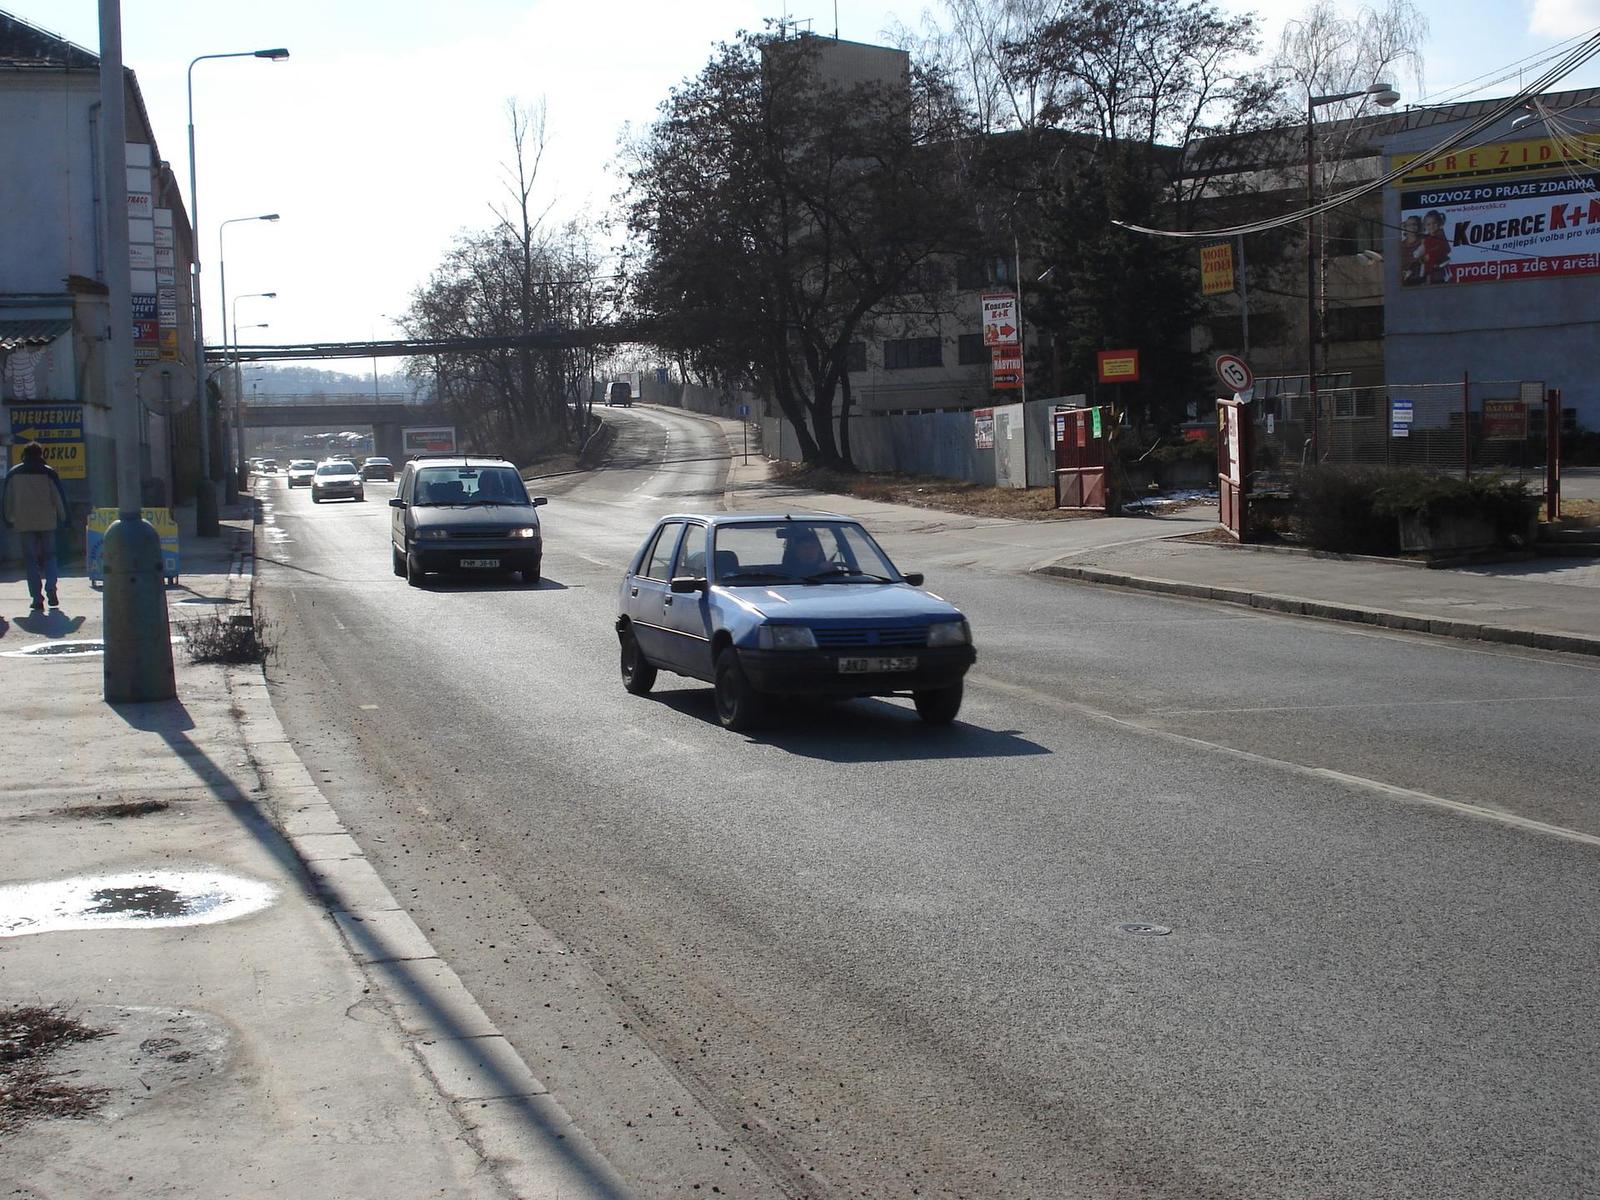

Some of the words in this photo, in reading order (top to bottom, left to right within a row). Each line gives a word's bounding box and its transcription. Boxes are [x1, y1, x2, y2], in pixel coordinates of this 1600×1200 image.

[1420, 190, 1472, 205] ROZVOZ
[1475, 188, 1493, 199] PO
[1496, 183, 1536, 197] PRAZE
[1539, 178, 1596, 193] ZDARMA
[1453, 213, 1547, 247] KOBERCE
[1502, 237, 1538, 251] nejlepší
[1540, 232, 1565, 243] volba
[1567, 230, 1583, 240] pro
[1456, 261, 1518, 282] prodejna
[1523, 258, 1548, 272] zde
[1550, 260, 1560, 271] v
[991, 309, 1009, 318] K+K
[1224, 364, 1244, 385] 15
[12, 410, 82, 425] PNEUSERVIS
[43, 446, 77, 460] OSKLO
